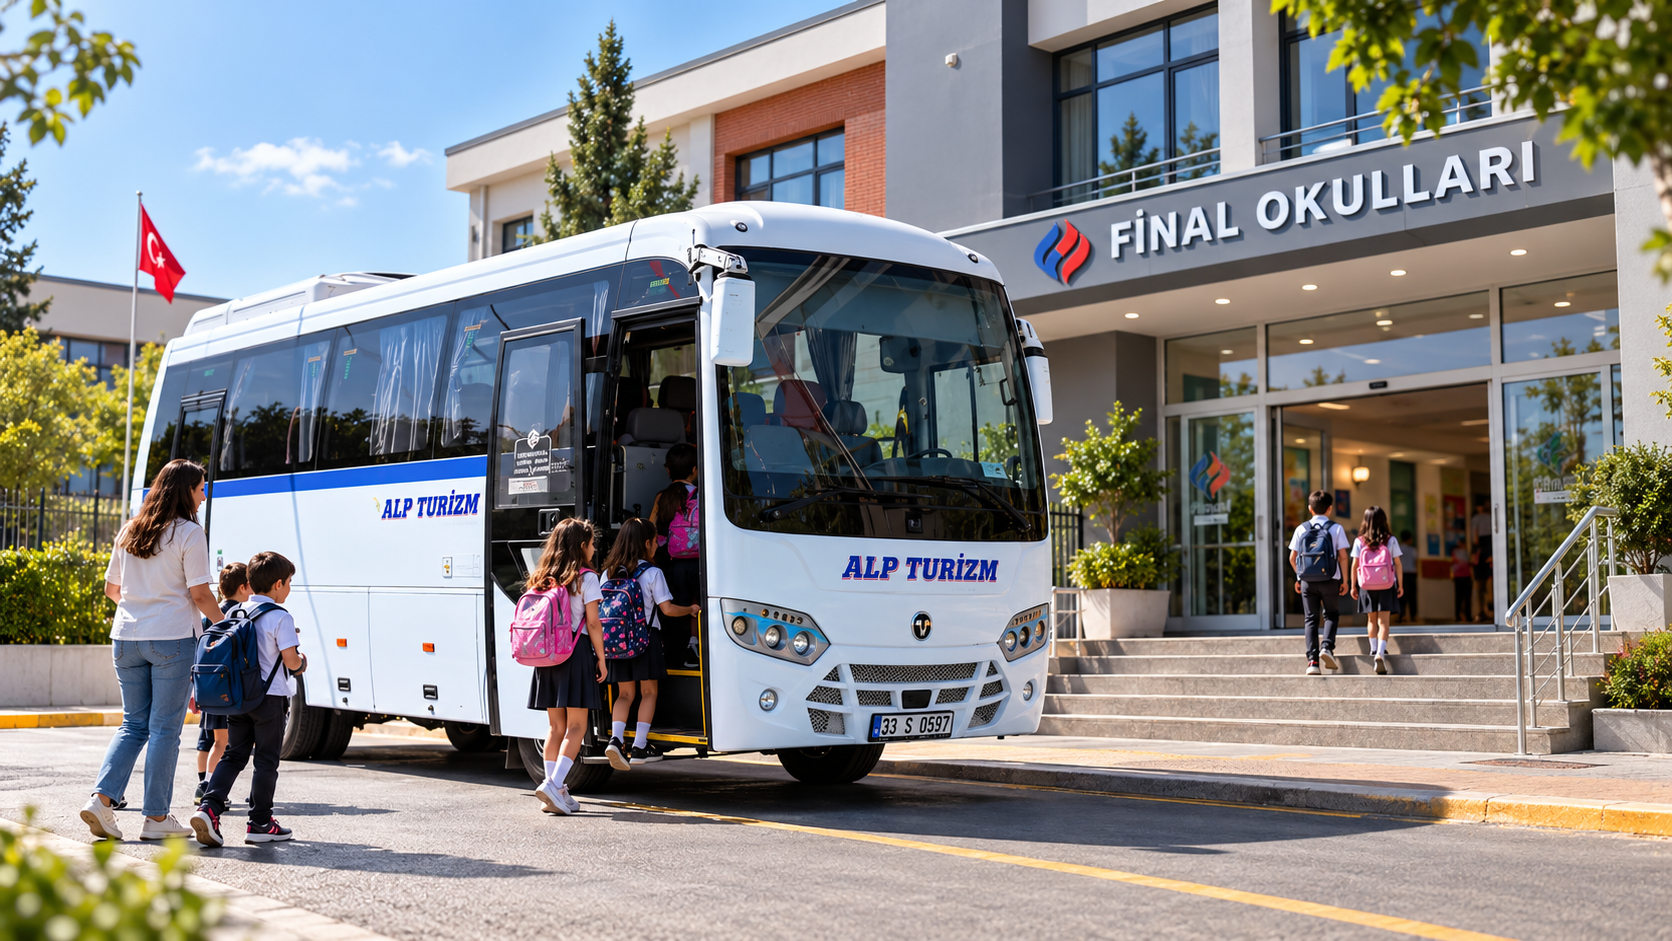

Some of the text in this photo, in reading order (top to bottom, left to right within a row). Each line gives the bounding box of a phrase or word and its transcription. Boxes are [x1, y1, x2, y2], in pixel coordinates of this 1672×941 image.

[1110, 139, 1535, 260] FİNAL OKULLARI
[381, 489, 480, 520] ALP TURİZM
[842, 552, 999, 583] ALP TURİZM
[881, 715, 950, 735] 33 S 0597
